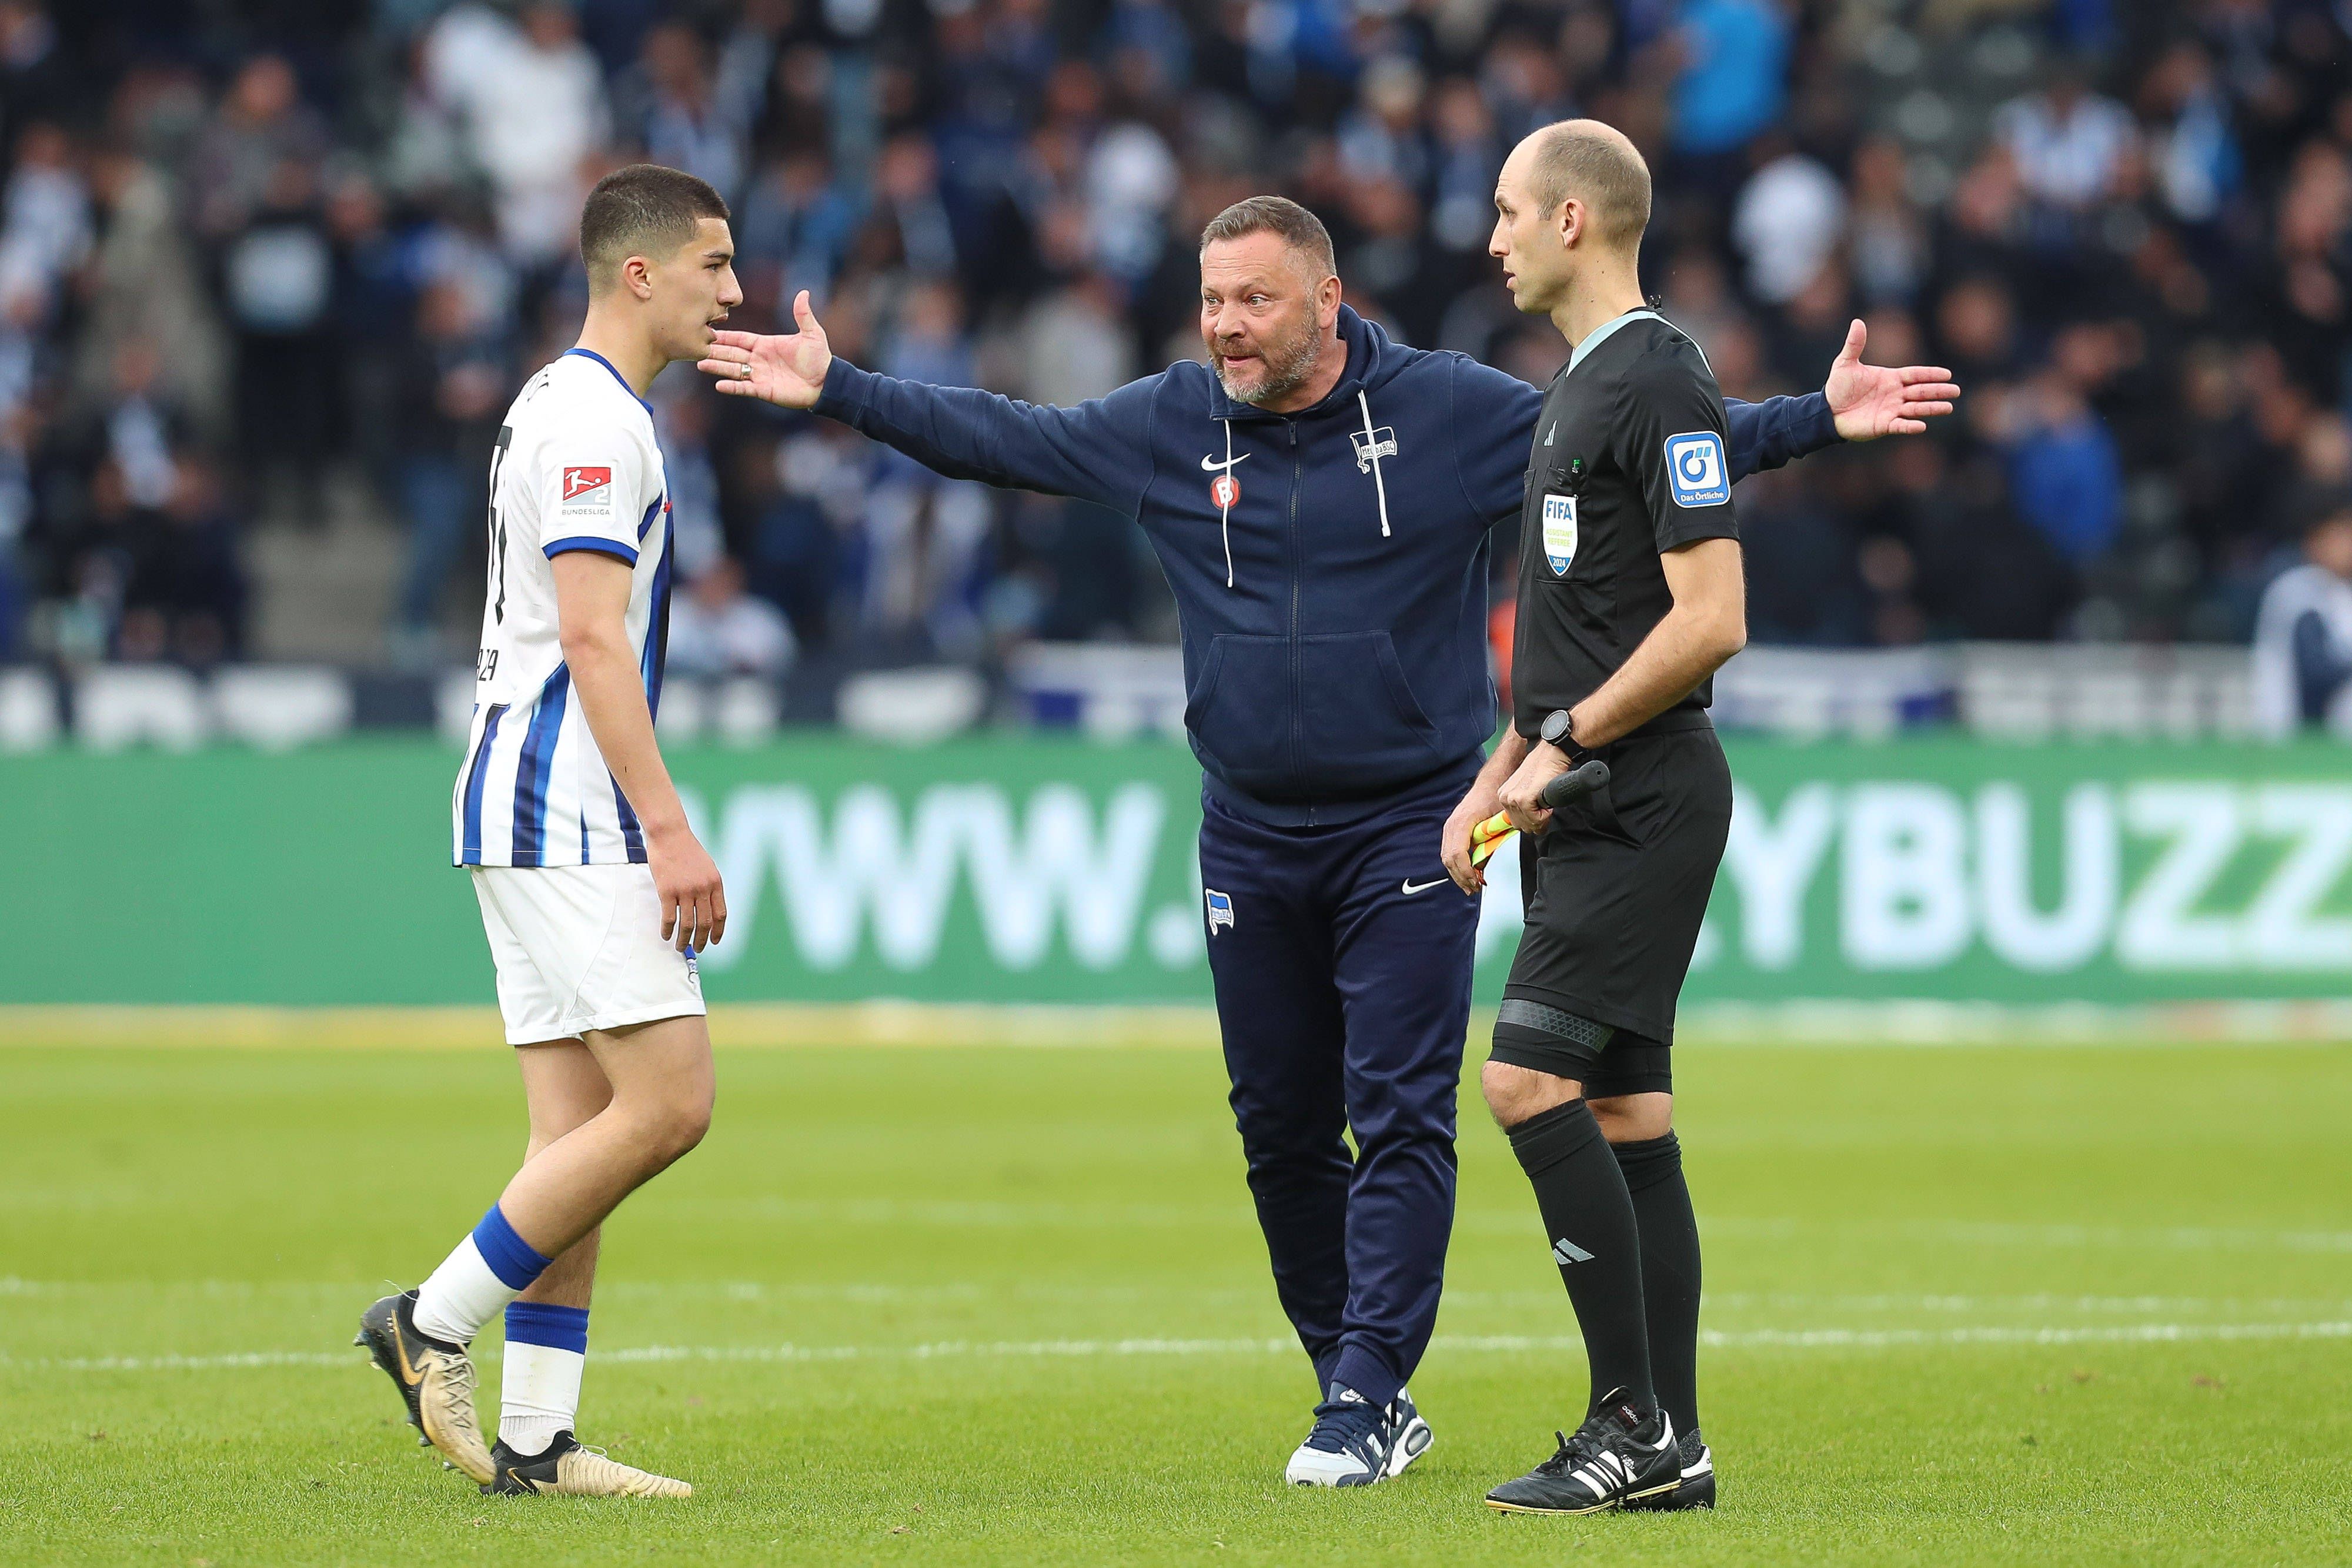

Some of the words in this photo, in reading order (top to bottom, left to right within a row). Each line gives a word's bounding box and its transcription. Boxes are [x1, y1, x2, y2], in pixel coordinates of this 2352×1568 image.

[594, 486, 609, 503] 2
[1681, 494, 1694, 502] Das
[1695, 492, 1724, 501] Örtliche
[1546, 500, 1572, 520] FIFA
[1546, 528, 1572, 537] ASSISTANT
[1548, 537, 1571, 547] REFEREE
[1553, 557, 1566, 568] 2024
